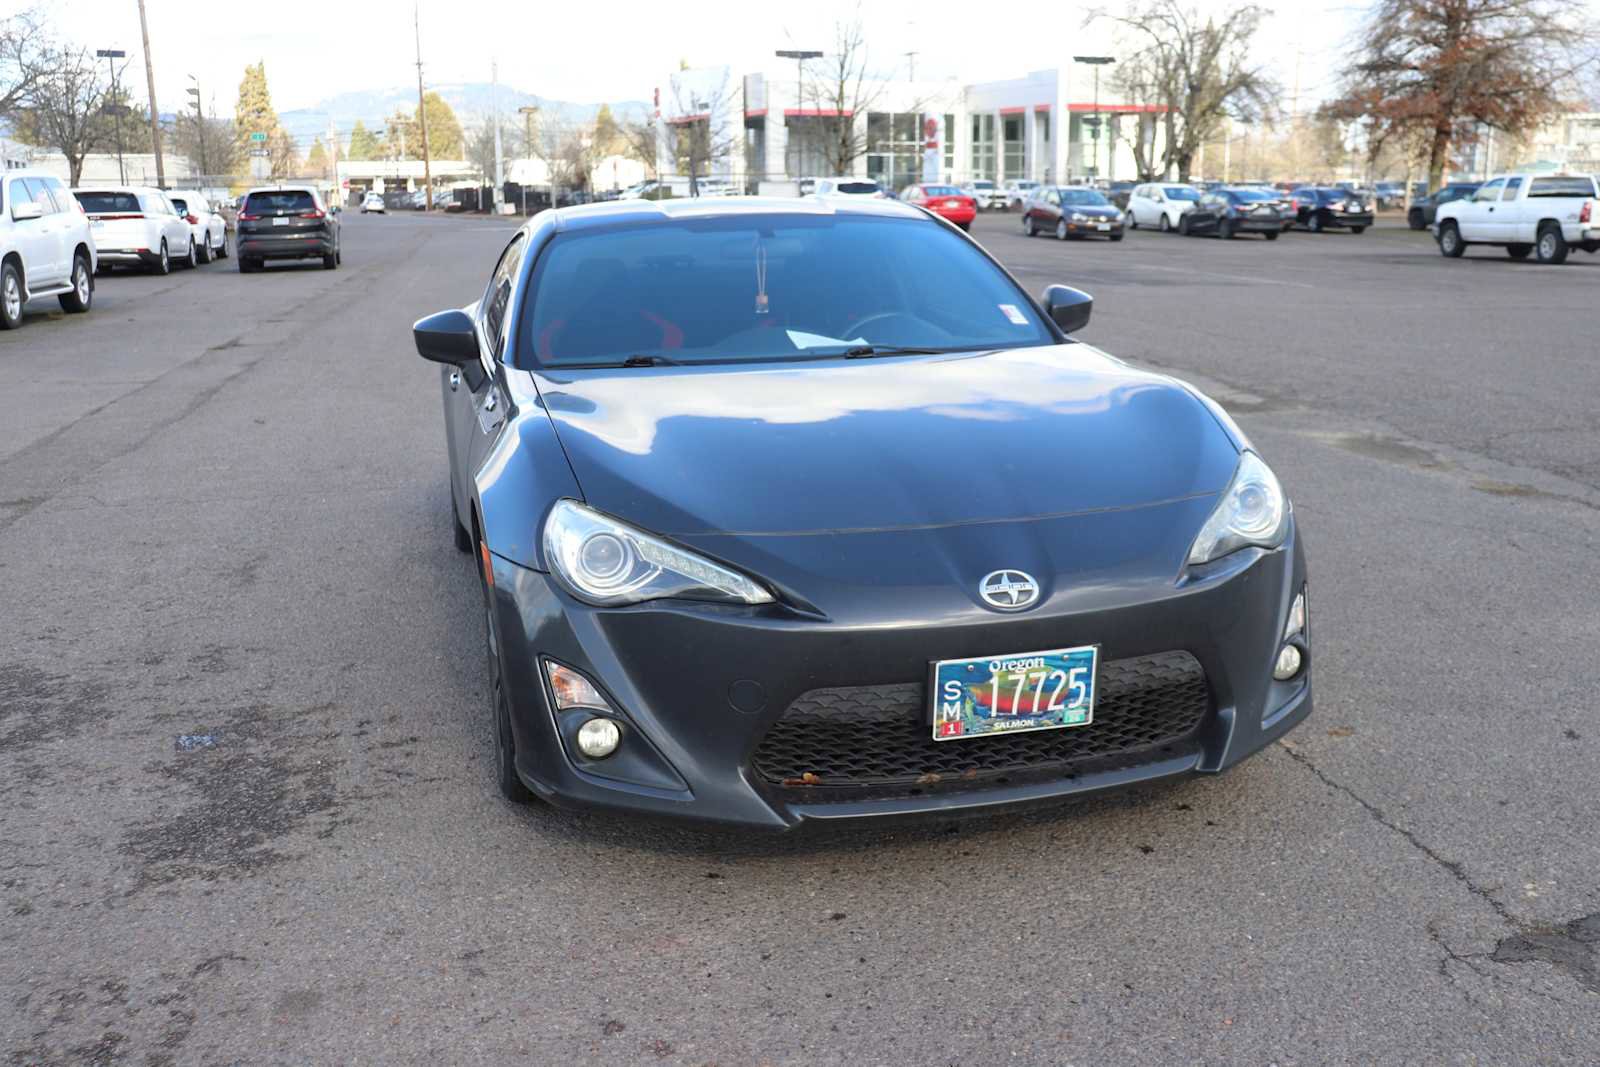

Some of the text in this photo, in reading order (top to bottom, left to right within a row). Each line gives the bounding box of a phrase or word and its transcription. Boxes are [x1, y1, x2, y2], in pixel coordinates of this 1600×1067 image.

[989, 658, 1044, 673] Oregon
[990, 667, 1088, 717] 17725
[993, 720, 1034, 729] SALMON
